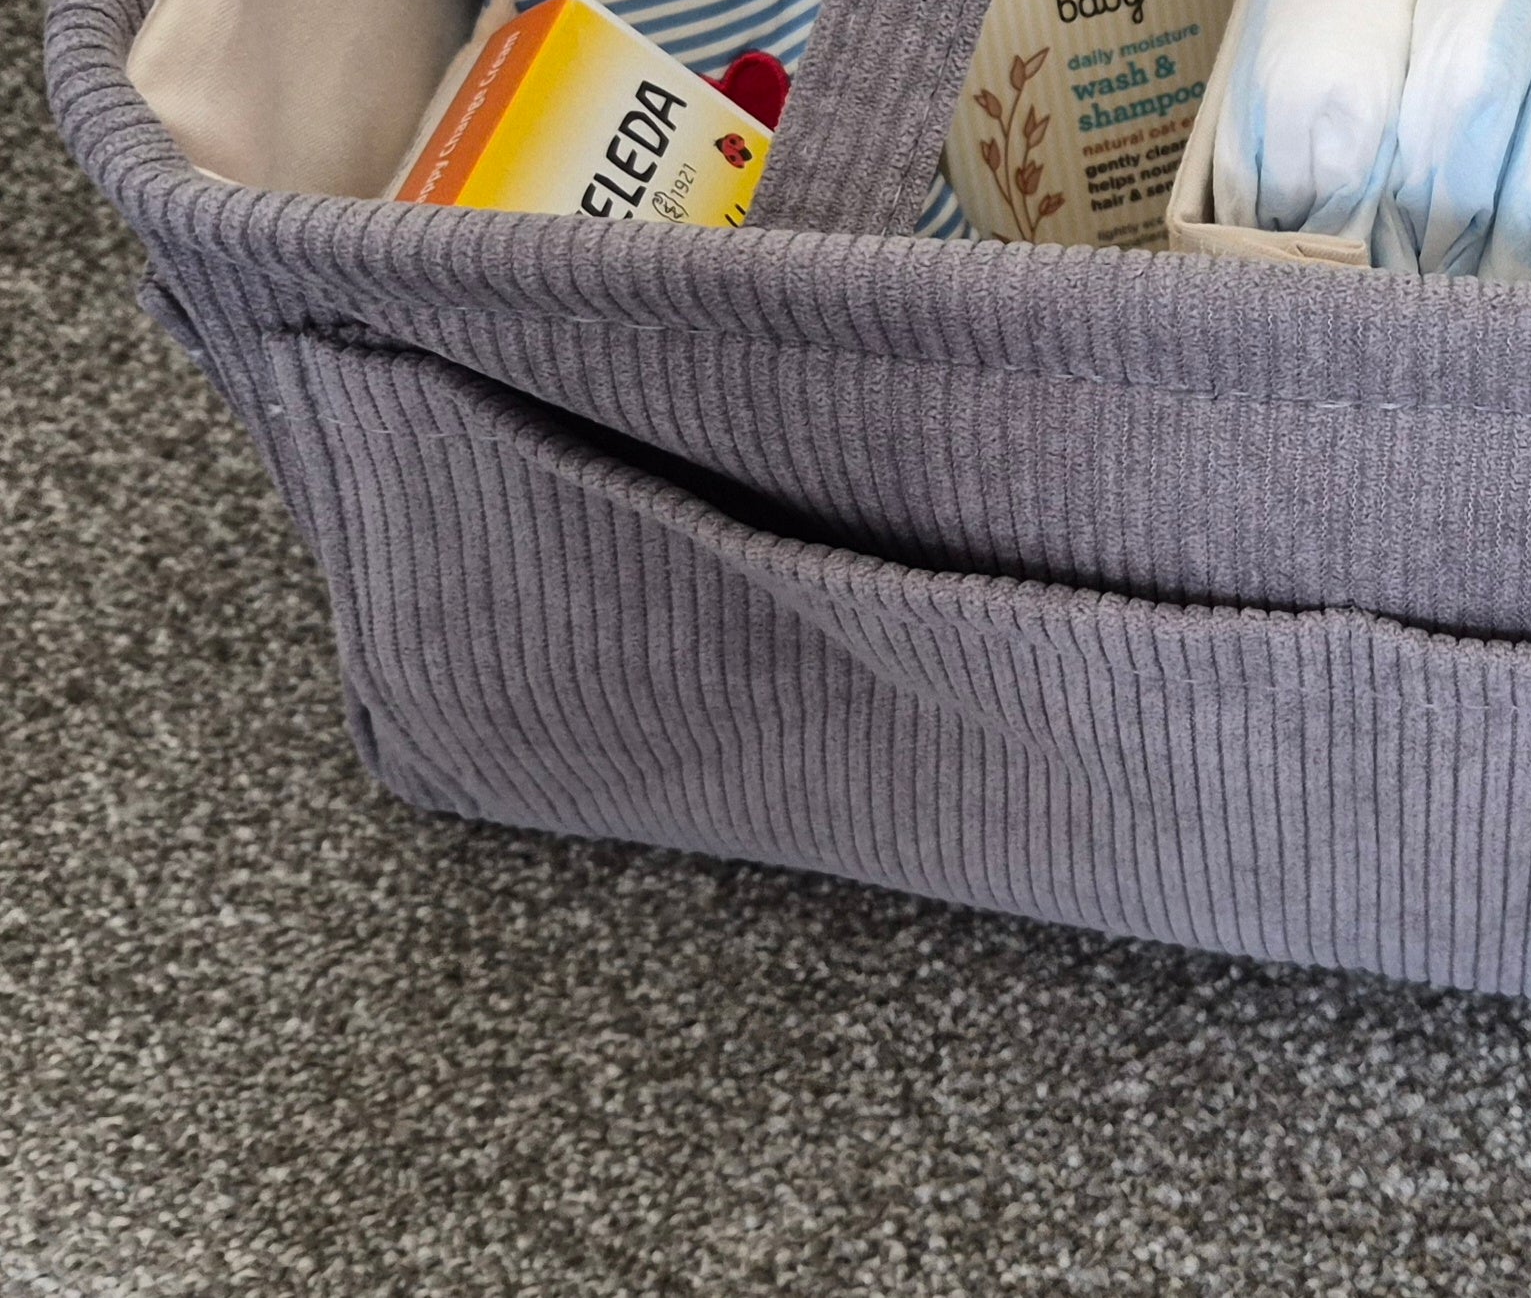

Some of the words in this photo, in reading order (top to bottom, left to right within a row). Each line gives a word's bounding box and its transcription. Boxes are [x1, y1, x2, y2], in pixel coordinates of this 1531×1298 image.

[1067, 48, 1114, 71] daily
[1120, 24, 1200, 57] moisture
[440, 88, 488, 158] Change
[479, 30, 522, 88] Cream
[1071, 61, 1149, 101] wash
[1155, 55, 1176, 79] &
[1078, 81, 1206, 131] shampoo
[576, 80, 688, 219] ELEDA
[1083, 129, 1144, 157] natural
[1149, 120, 1176, 139] oat
[671, 162, 697, 199] 1921
[1085, 154, 1140, 179] gently
[1088, 174, 1136, 194] helps
[1091, 193, 1124, 212] hair
